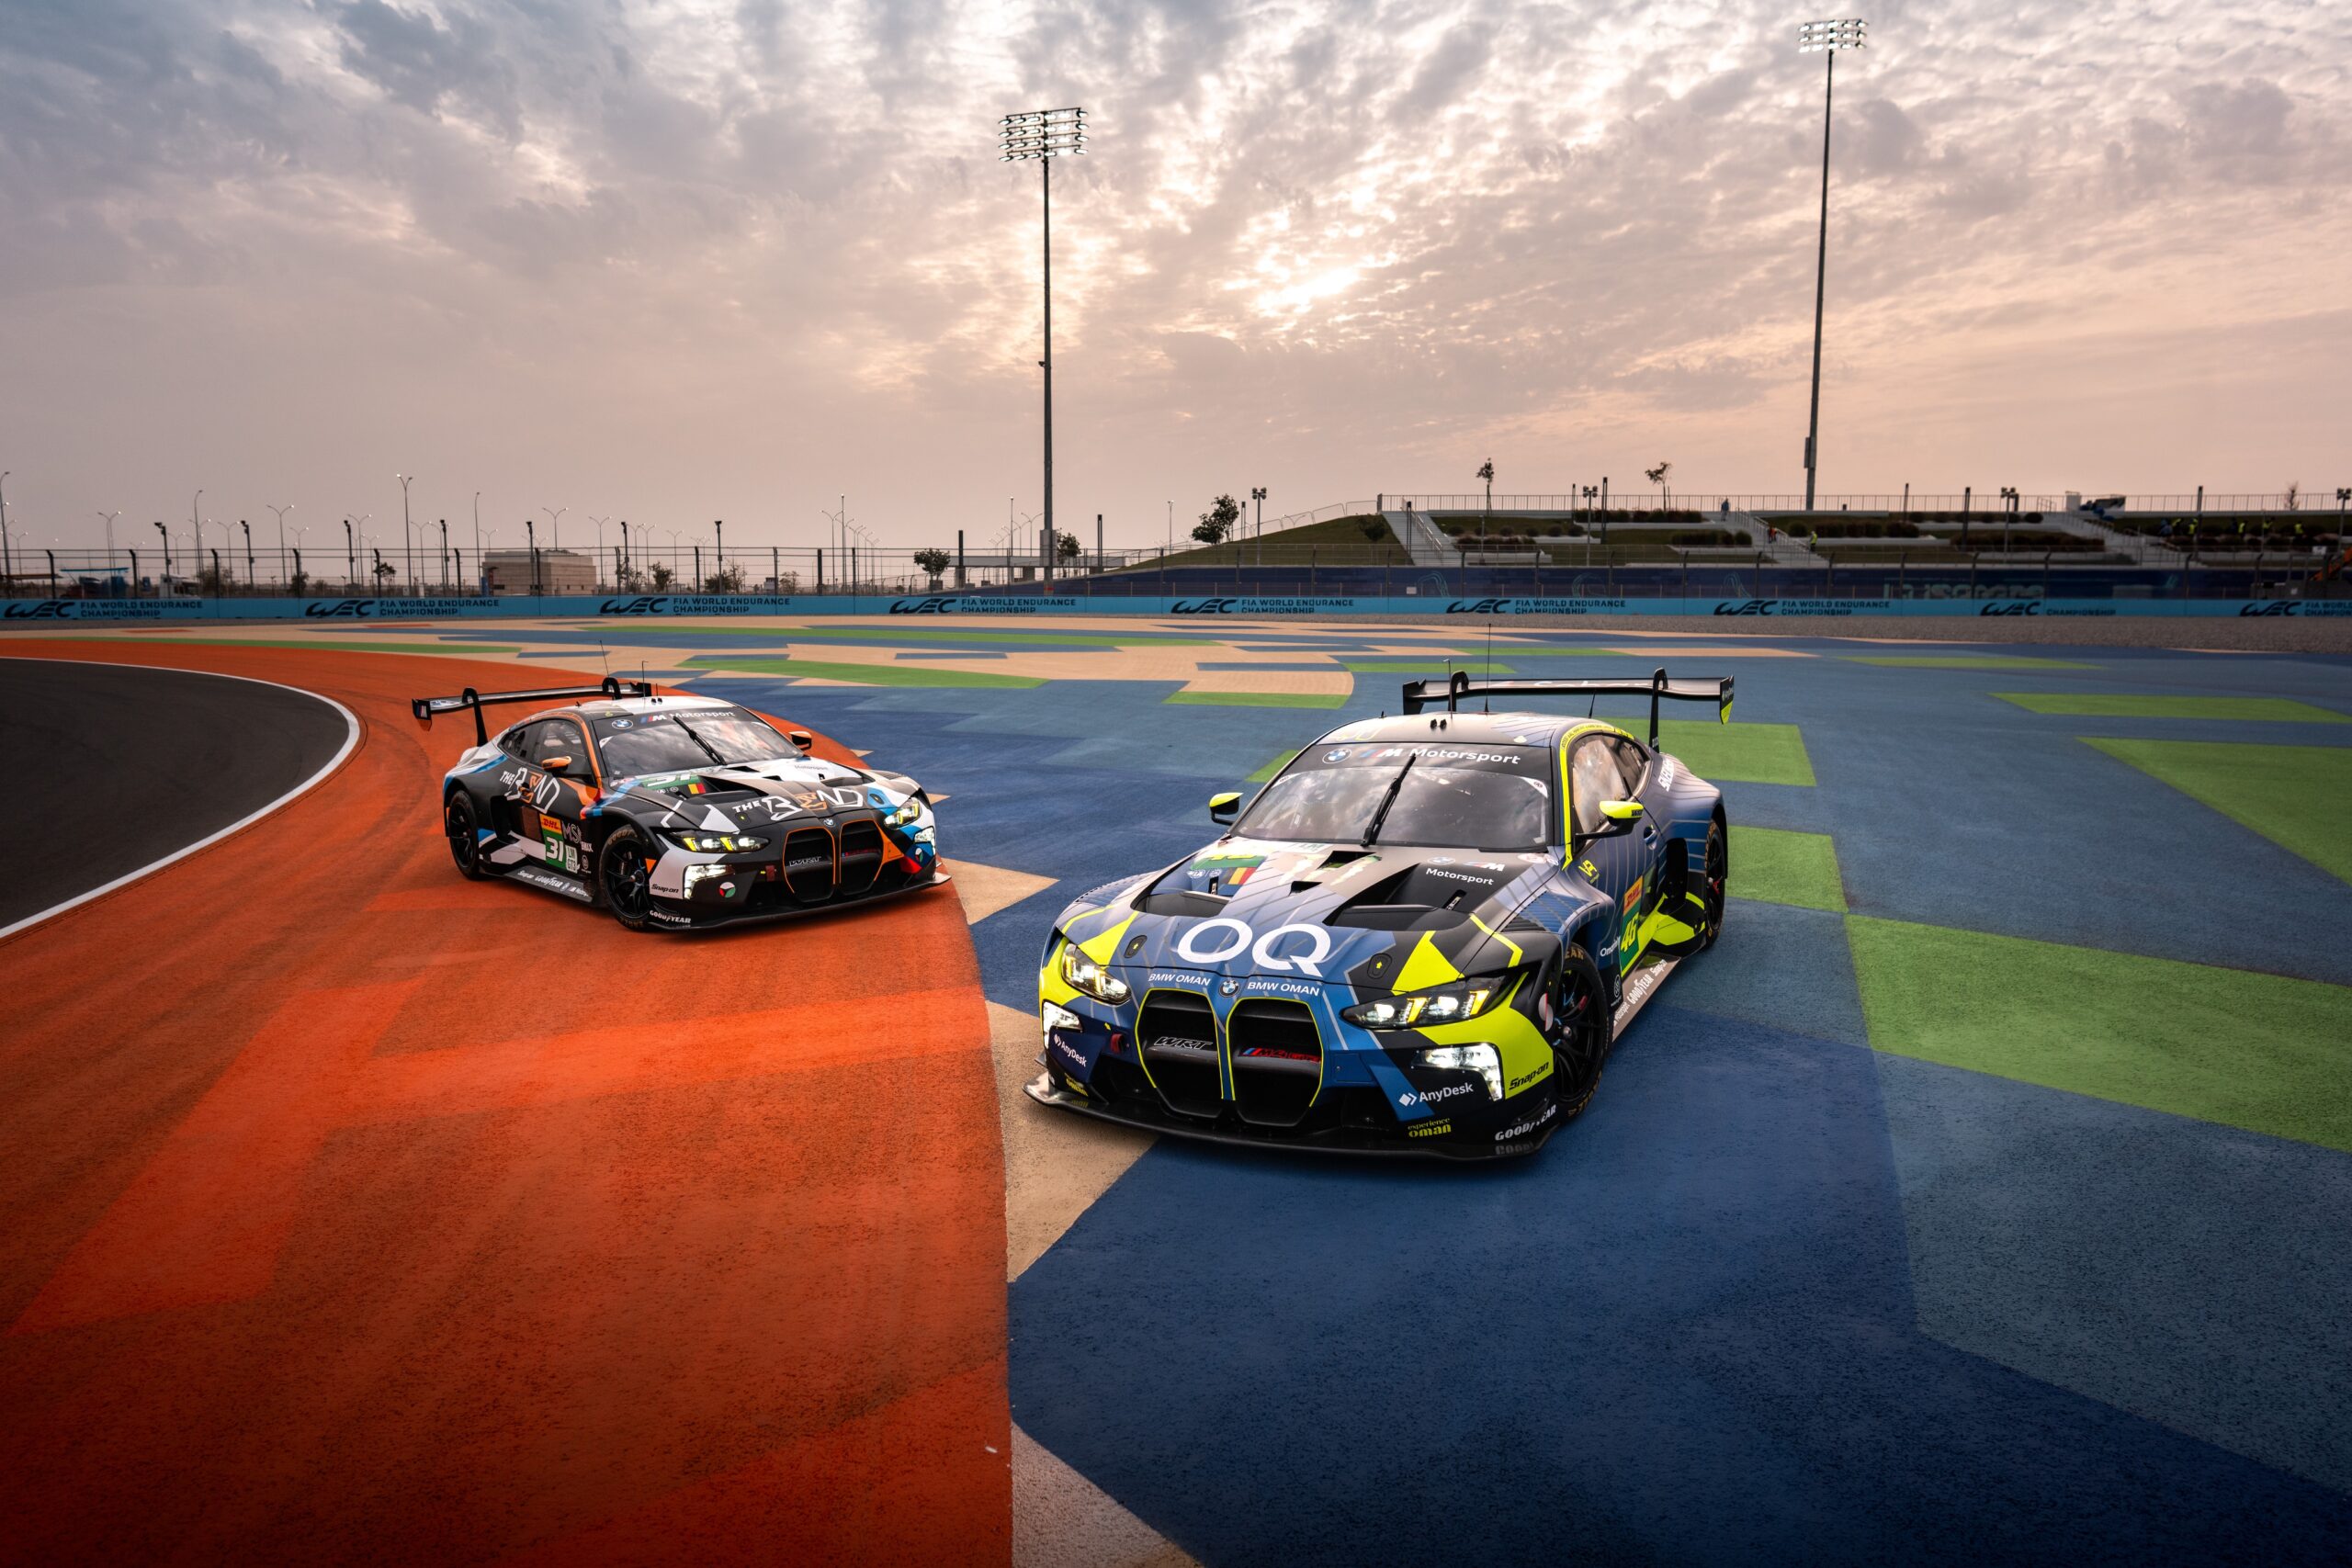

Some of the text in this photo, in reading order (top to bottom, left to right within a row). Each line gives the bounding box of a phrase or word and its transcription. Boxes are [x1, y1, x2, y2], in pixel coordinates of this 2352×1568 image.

[4, 601, 75, 617] WEC
[140, 601, 202, 609] ENDURANCE
[305, 600, 375, 616] WEC
[438, 599, 499, 607] ENDURANCE
[600, 597, 668, 614] WEC
[889, 598, 956, 614] WEC
[1170, 598, 1237, 614] WEC
[1446, 599, 1511, 614] WEC
[1713, 600, 1779, 615] WEC
[2239, 602, 2302, 616] WEC
[670, 711, 735, 719] Motorsport
[1409, 748, 1521, 764] Motorsport
[500, 770, 516, 785] THE
[732, 800, 762, 813] THE
[543, 818, 560, 830] DHL
[546, 837, 564, 862] 31
[1426, 867, 1495, 886] Motorsport
[650, 884, 679, 893] Snap-on
[1626, 885, 1640, 907] DHL
[649, 909, 692, 923] GOODYEAR
[1621, 911, 1639, 953] 46
[1177, 918, 1331, 978] OQ
[1148, 973, 1212, 987] BMW OMAN
[1247, 981, 1320, 997] BMW OMAN
[1627, 974, 1654, 1005] GOODYEAR
[1153, 1036, 1214, 1050] WRT
[1061, 1041, 1088, 1067] AnyDesk
[1509, 1062, 1550, 1090] Snap-on
[1419, 1082, 1475, 1103] AnyDesk
[1408, 1117, 1451, 1130] experience
[1408, 1123, 1452, 1138] oman
